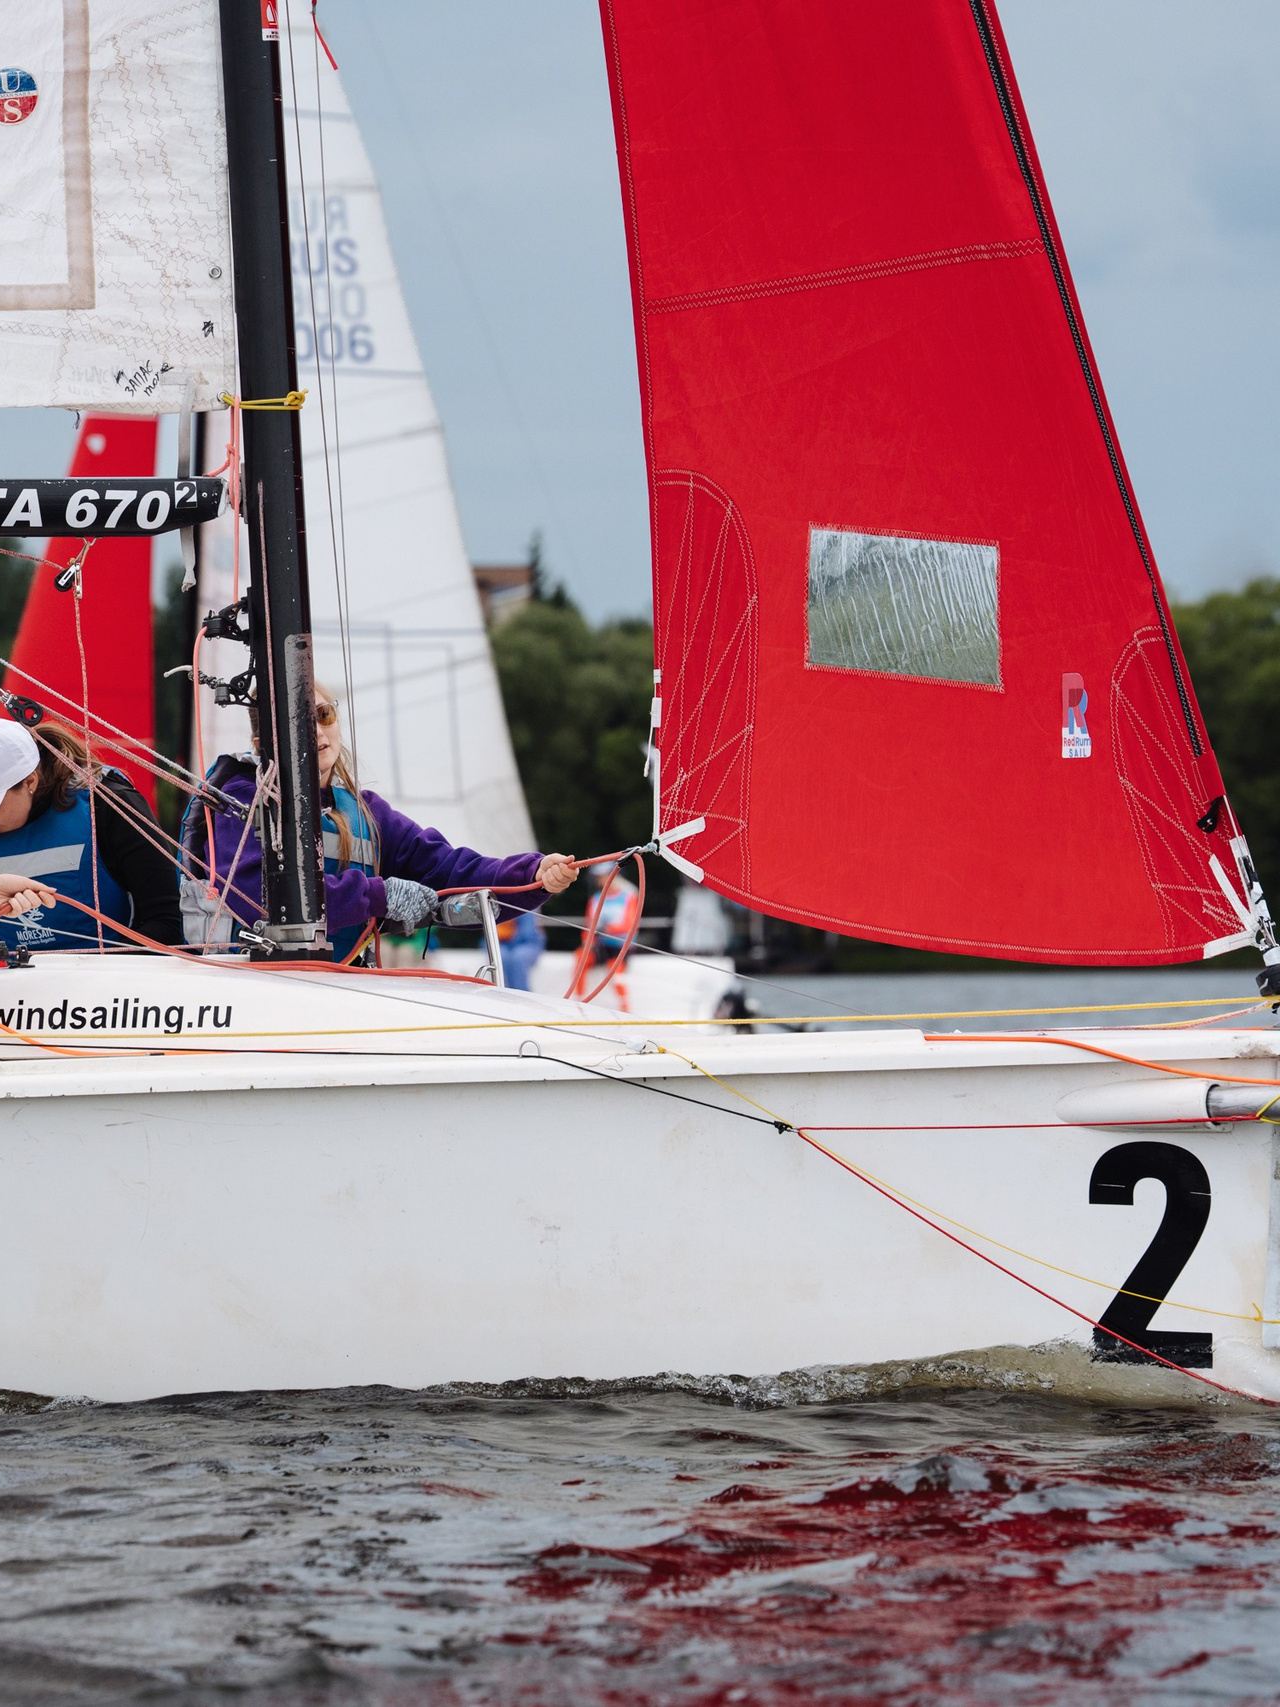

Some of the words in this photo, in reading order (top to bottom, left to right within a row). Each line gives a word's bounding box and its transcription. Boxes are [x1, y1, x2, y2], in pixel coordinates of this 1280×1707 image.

[1063, 736, 1091, 747] RedRum
[1068, 748, 1087, 758] SAIL
[1088, 1141, 1214, 1369] 2
